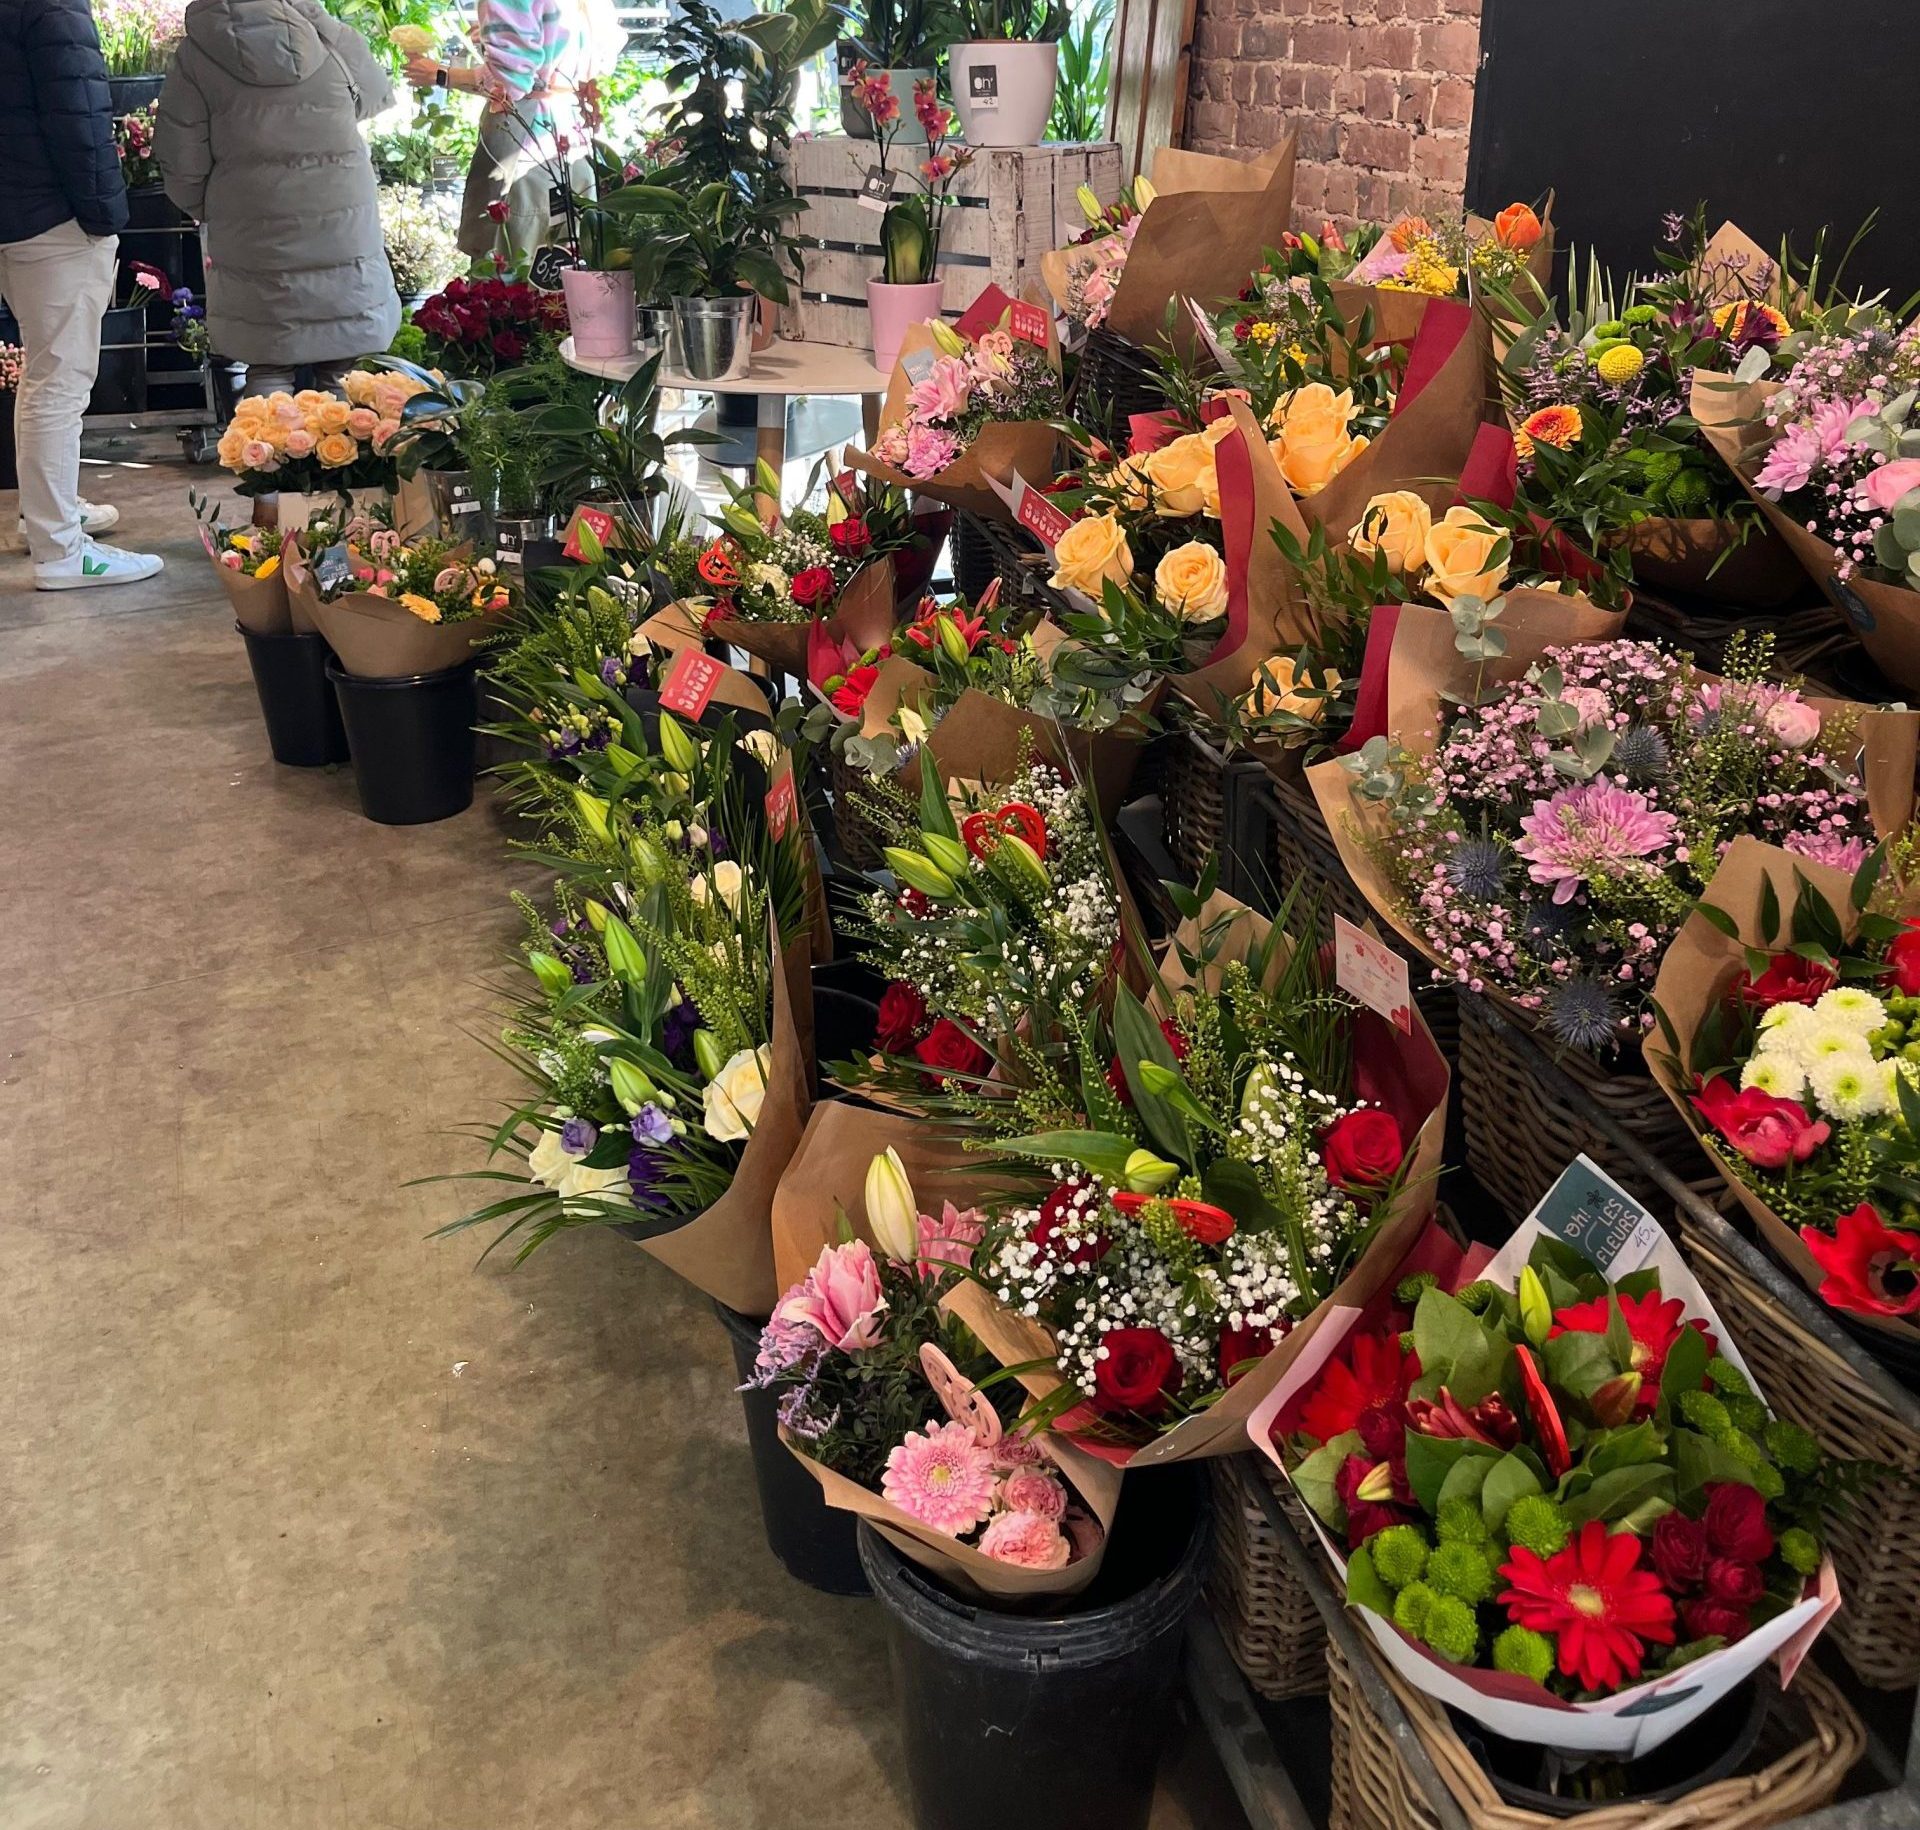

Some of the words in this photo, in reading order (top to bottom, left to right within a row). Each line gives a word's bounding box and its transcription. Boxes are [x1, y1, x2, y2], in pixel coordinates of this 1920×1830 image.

[536, 253, 563, 281] 6,5
[1563, 1207, 1592, 1238] Oh!
[1597, 1198, 1623, 1228] LES
[1596, 1210, 1639, 1266] FLEURS
